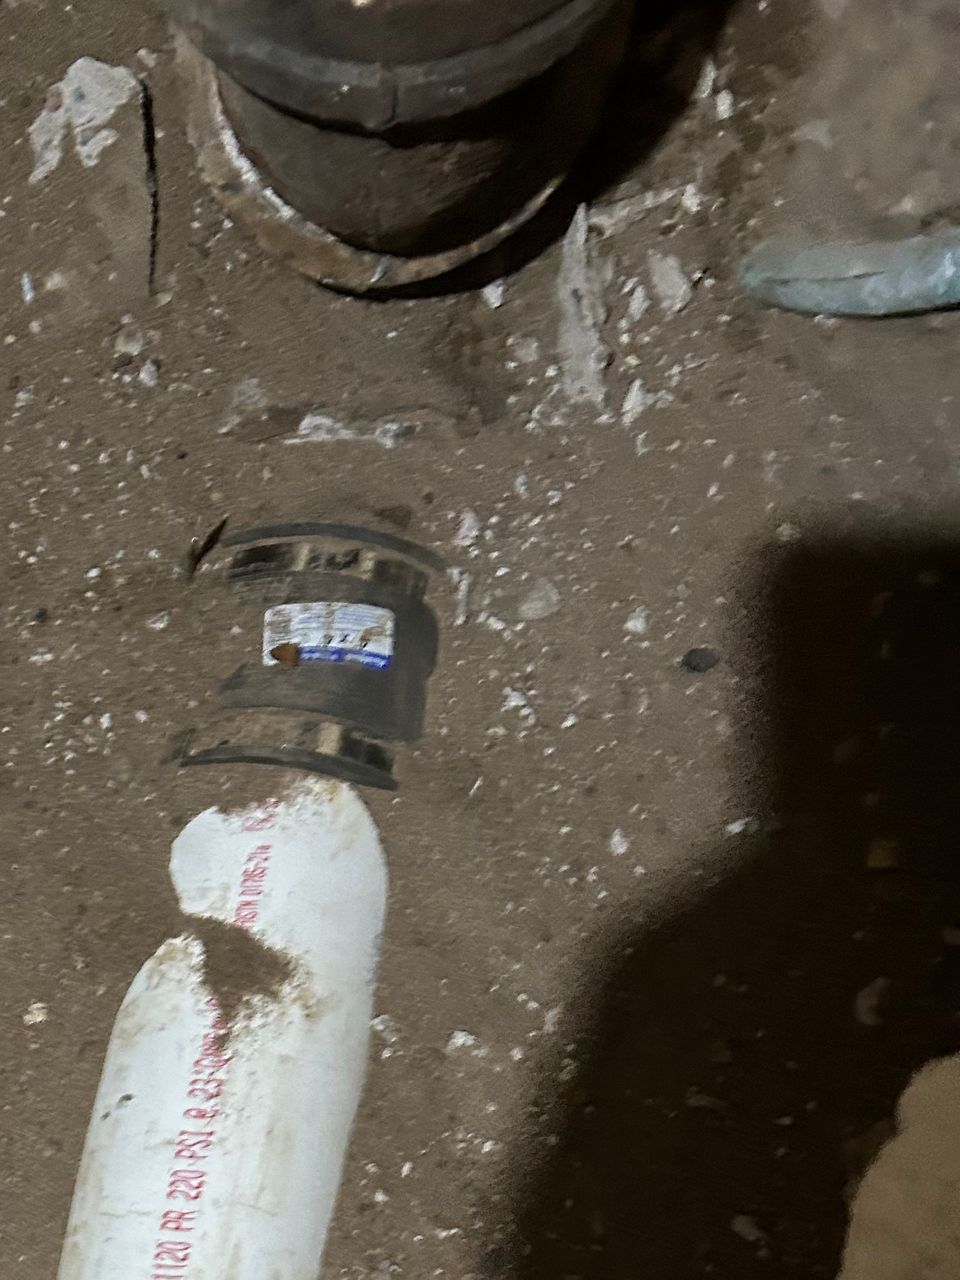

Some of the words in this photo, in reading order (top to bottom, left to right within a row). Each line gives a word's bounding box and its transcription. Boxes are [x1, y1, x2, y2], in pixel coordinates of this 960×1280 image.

[175, 1129, 215, 1161] PSI
[168, 1169, 206, 1201] 220
[160, 1209, 196, 1233] PR
[153, 1241, 192, 1280] 1120
